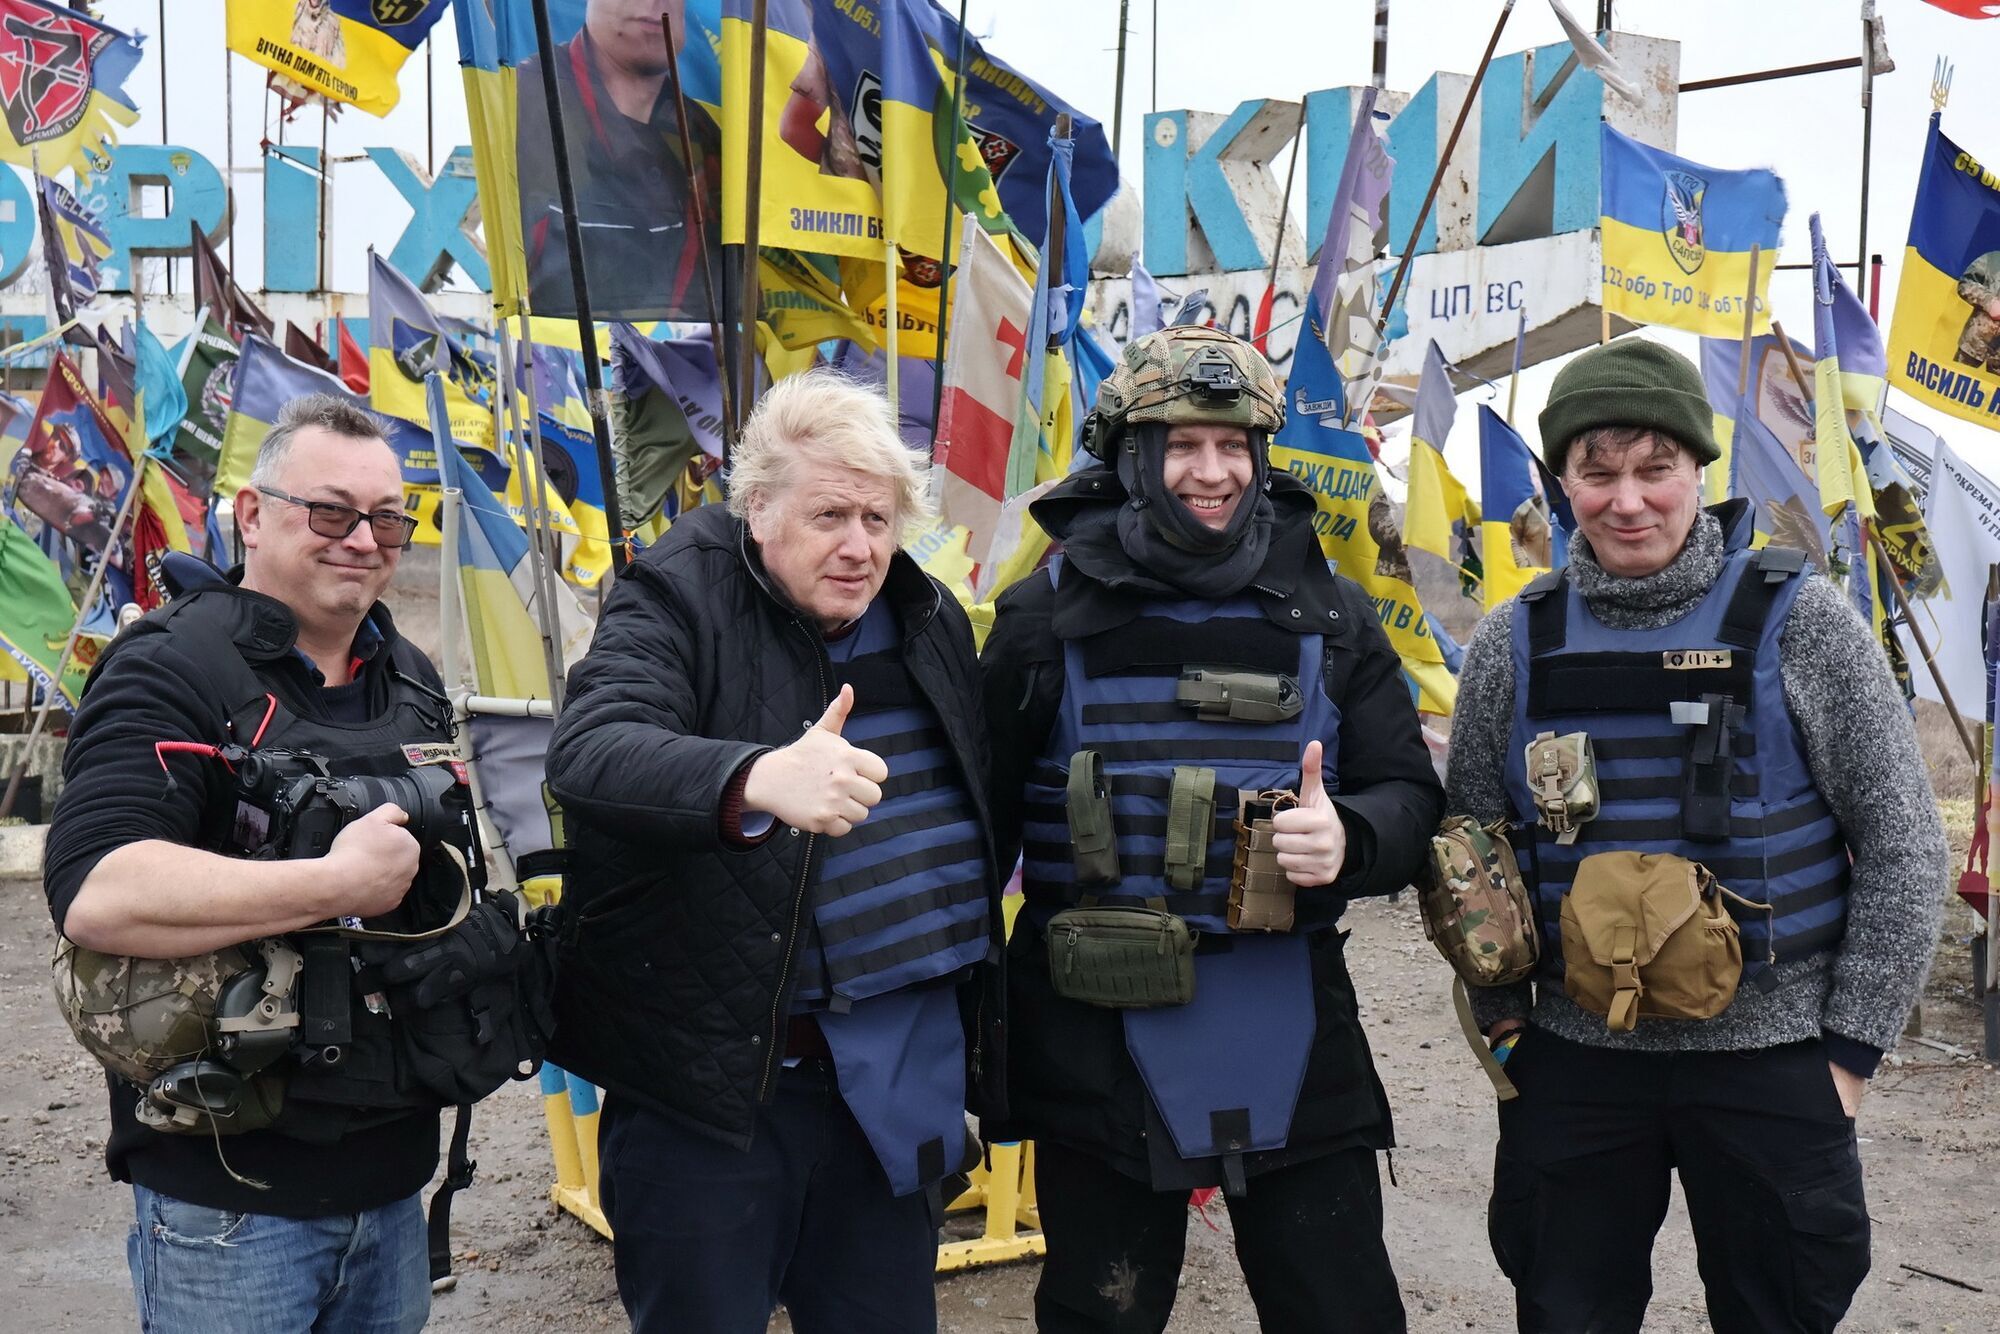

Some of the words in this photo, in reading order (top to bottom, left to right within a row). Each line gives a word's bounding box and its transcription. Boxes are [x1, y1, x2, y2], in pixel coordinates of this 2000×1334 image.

[834, 0, 881, 39] 04.05.1
[256, 37, 292, 67] ВІЧНА
[331, 77, 358, 101] ГЕРОЮ
[790, 207, 864, 237] ЗНИКЛІ
[867, 216, 884, 241] БЕ
[1487, 280, 1524, 313] ВС
[1625, 276, 1657, 301] обр
[1662, 281, 1694, 306] ТрО
[1714, 296, 1732, 314] об
[1906, 350, 1985, 410] ВАСИЛЬ
[1303, 400, 1334, 412] ЗАВЖДИ
